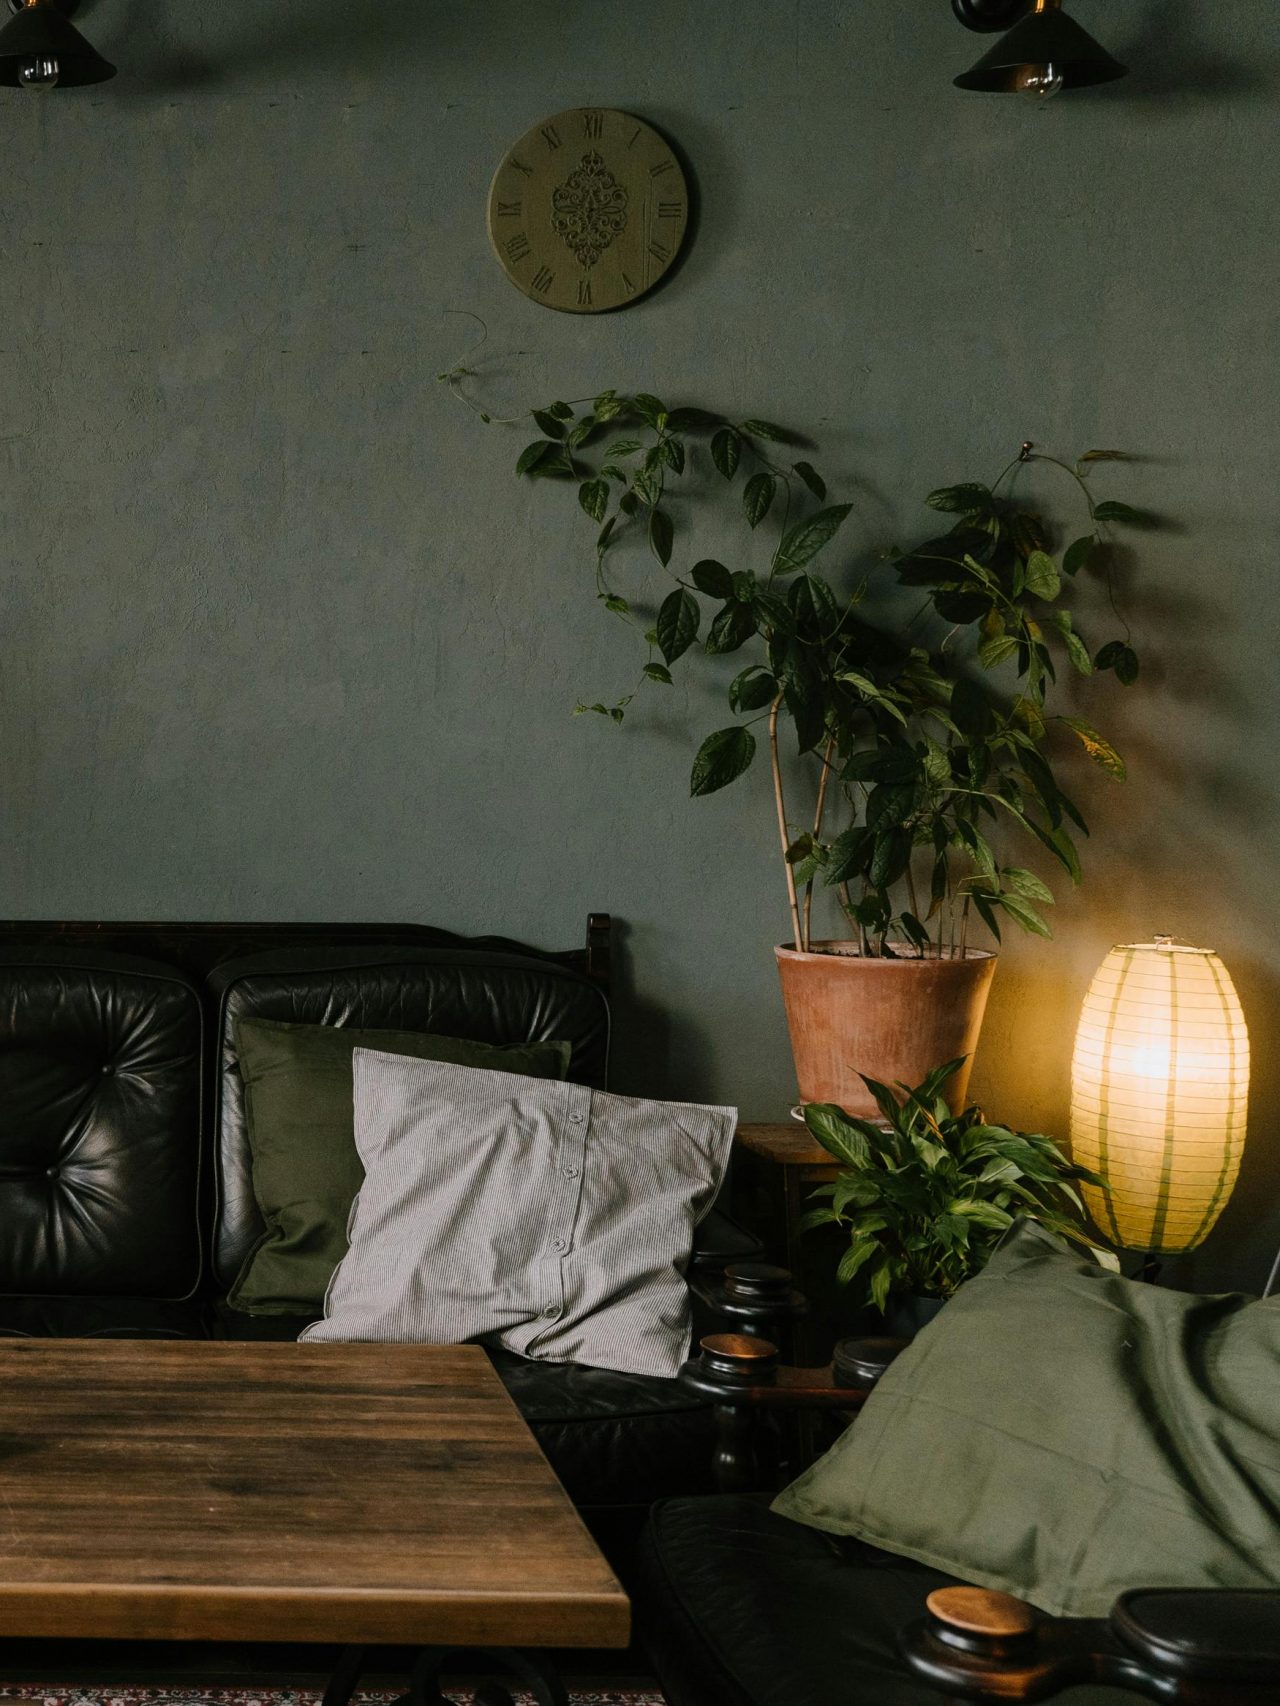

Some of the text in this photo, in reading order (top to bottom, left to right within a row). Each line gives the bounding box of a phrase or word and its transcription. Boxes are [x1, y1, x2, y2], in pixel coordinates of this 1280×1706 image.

[583, 113, 604, 139] XII
[541, 125, 562, 152] XI
[626, 127, 642, 151] I
[510, 158, 533, 178] X
[649, 160, 674, 178] II
[497, 201, 521, 217] IX
[658, 202, 682, 218] III
[504, 232, 530, 264] VIII
[648, 242, 671, 263] IV
[531, 266, 556, 294] VII
[577, 279, 592, 304] VI
[621, 272, 636, 295] V
